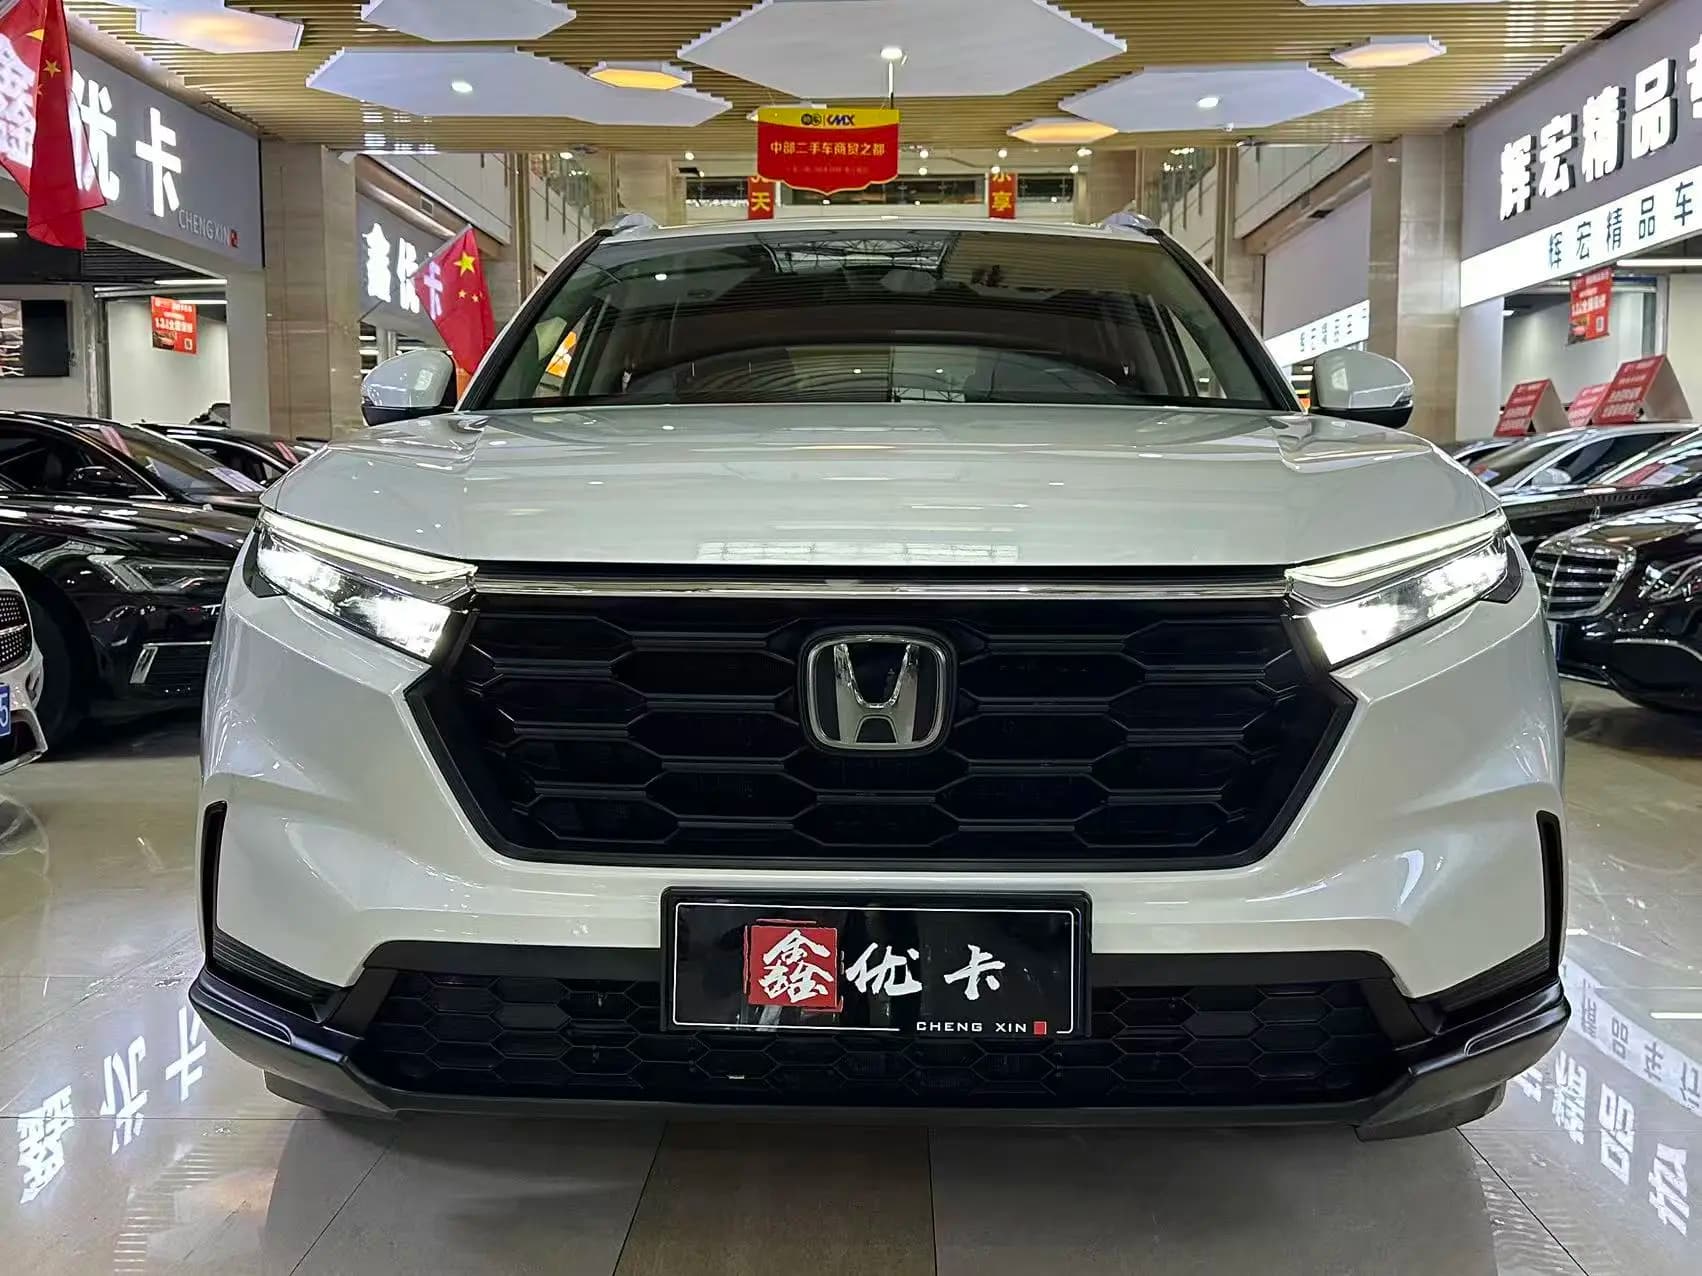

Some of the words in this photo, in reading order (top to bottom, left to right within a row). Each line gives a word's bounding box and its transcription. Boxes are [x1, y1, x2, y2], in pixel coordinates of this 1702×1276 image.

[770, 141, 885, 156] 中部二手车商贸之都
[1549, 180, 1695, 269] 辉宏精品车
[759, 928, 1006, 1004] 鑫优卡
[916, 1021, 983, 1033] CHENG
[995, 1022, 1027, 1033] XIN
